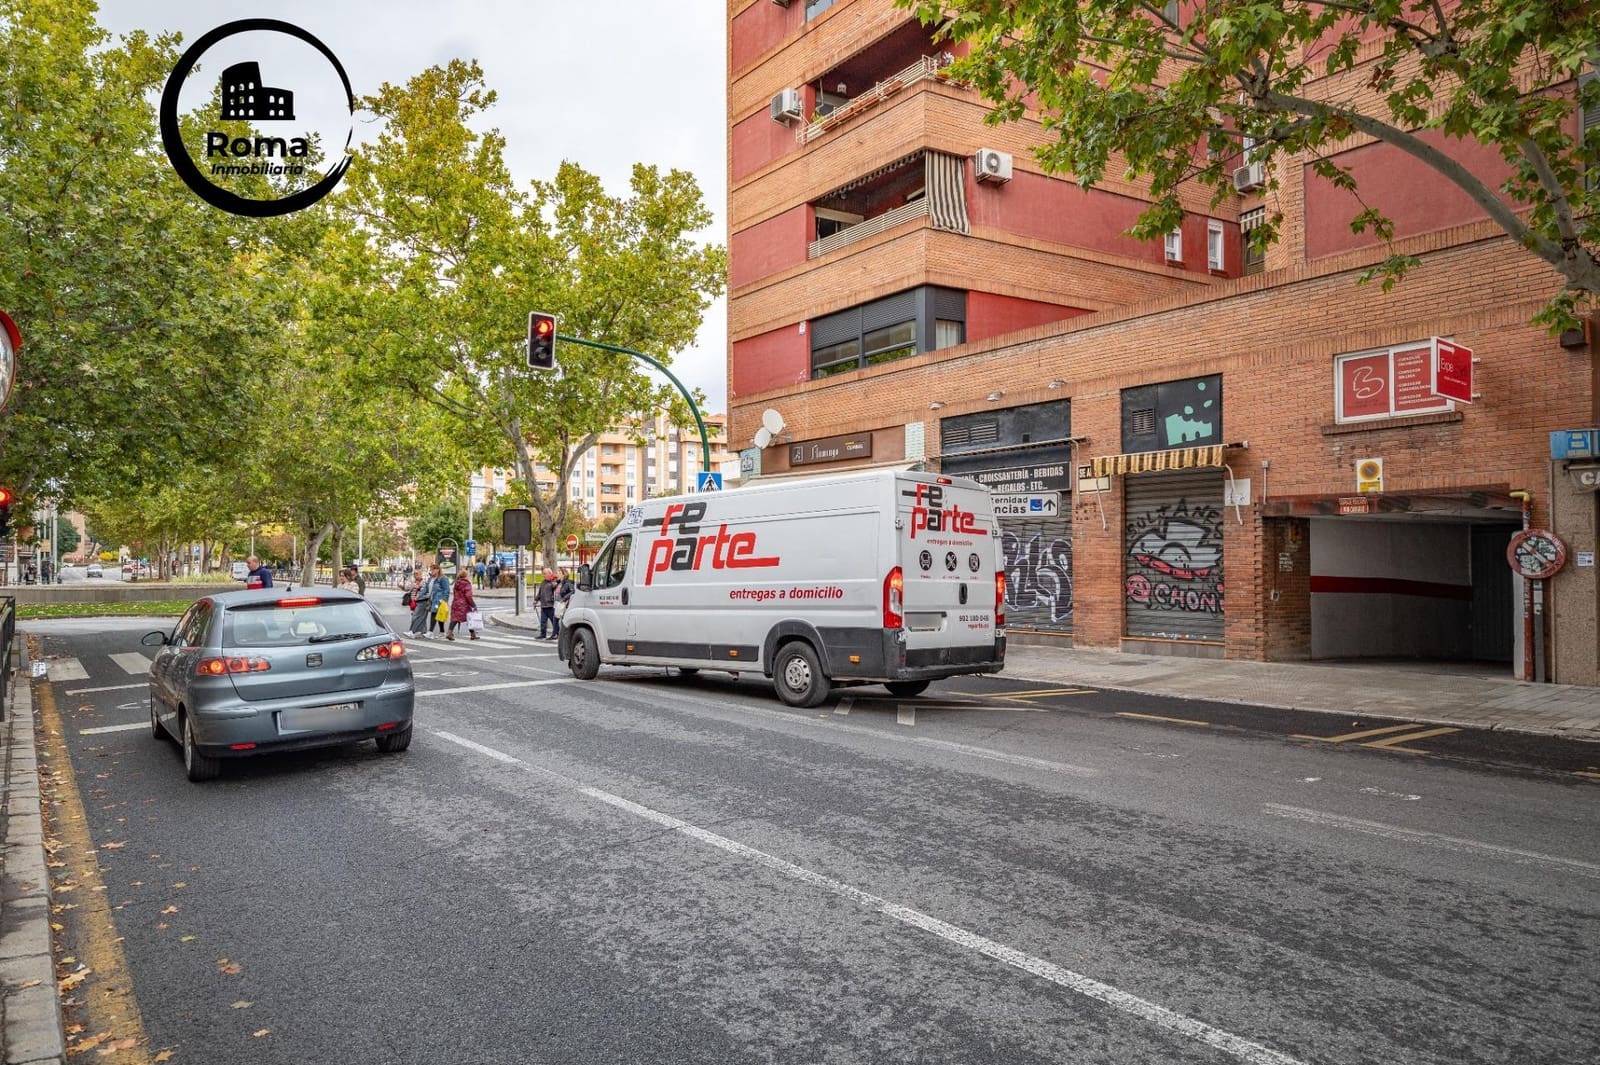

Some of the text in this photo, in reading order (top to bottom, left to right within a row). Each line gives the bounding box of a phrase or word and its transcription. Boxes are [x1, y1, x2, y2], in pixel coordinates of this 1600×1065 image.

[811, 444, 839, 459] Flamingo
[978, 468, 1029, 483] CROISSANTERÍA
[1033, 466, 1064, 478] BEBIDAS
[997, 482, 1026, 493] REGALOS
[992, 505, 1027, 514] ncias
[642, 501, 707, 537] re
[910, 503, 987, 540] parte
[644, 523, 780, 586] parte
[729, 586, 843, 602] entregas a domicilio
